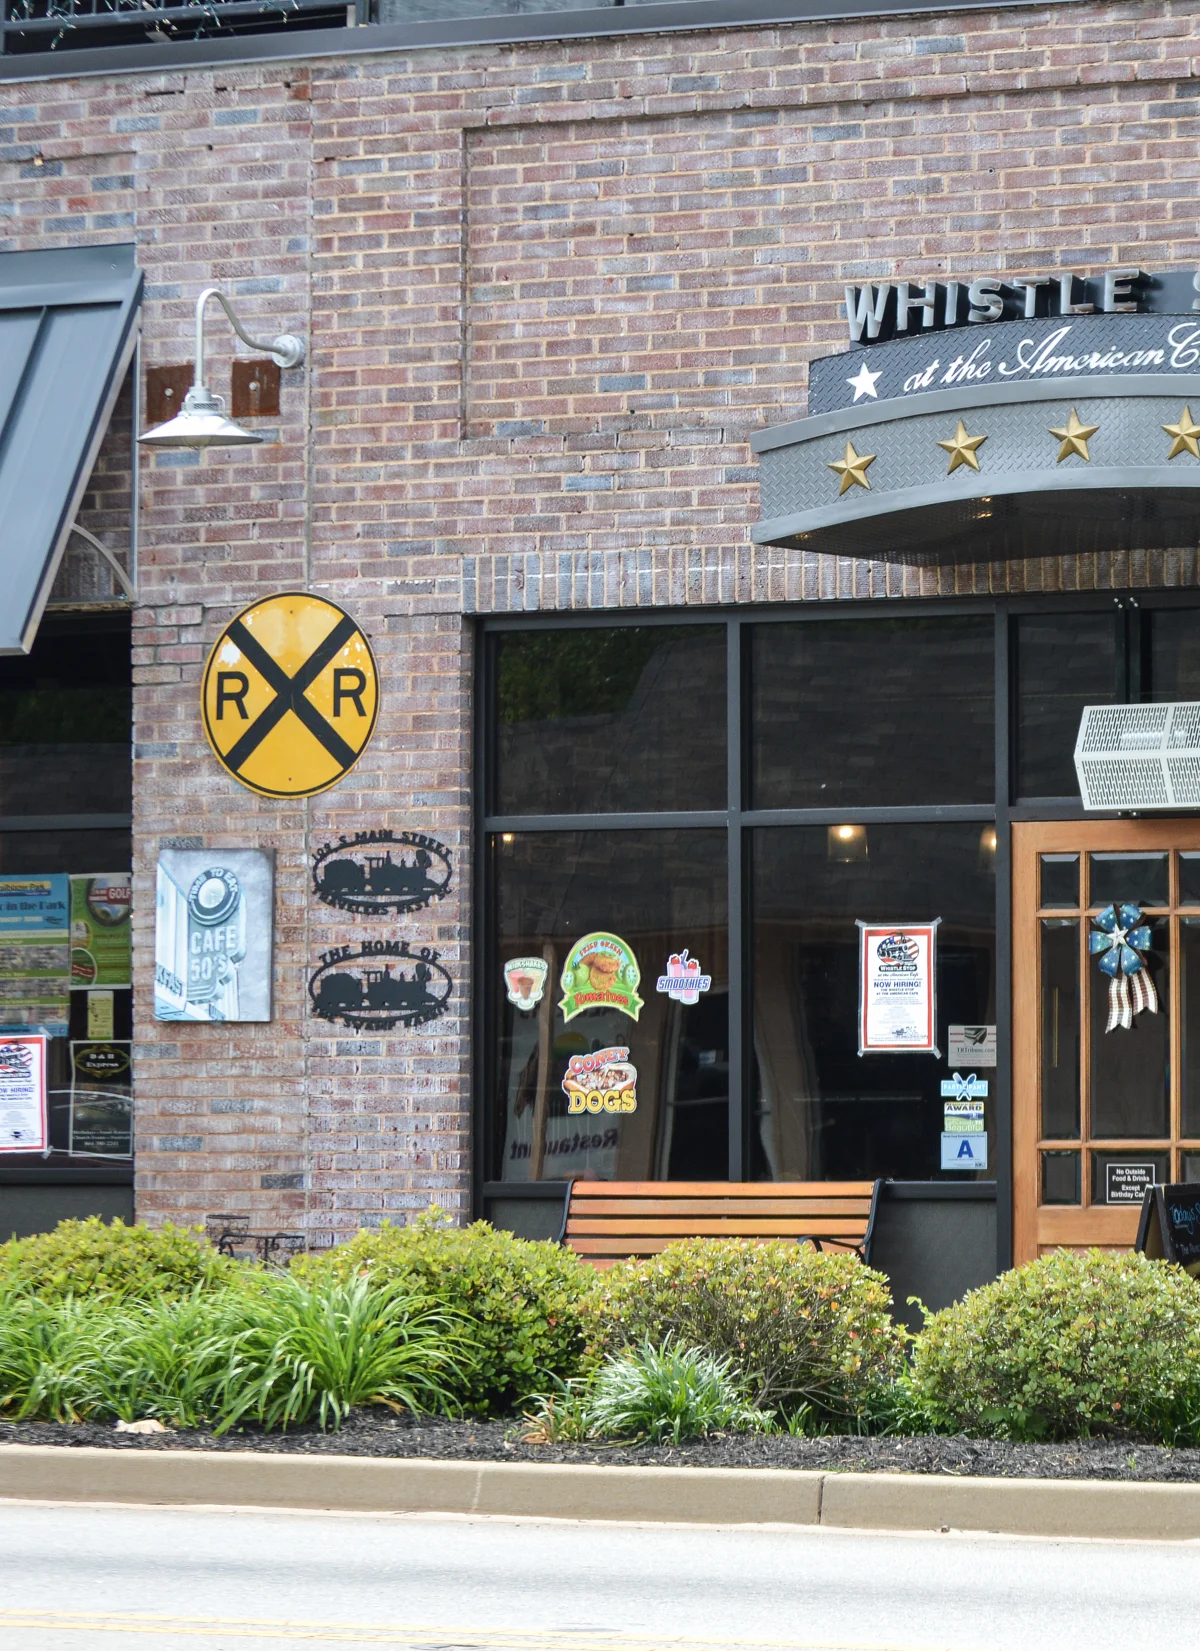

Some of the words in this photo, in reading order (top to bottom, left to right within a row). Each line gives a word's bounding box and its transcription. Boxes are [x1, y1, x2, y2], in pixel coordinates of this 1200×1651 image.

[845, 268, 1150, 342] WHISTLE
[903, 356, 940, 391] at
[940, 339, 991, 384] the
[998, 325, 1166, 376] American
[216, 670, 249, 720] R
[332, 667, 367, 718] R
[355, 829, 393, 841] MAIN
[402, 830, 453, 858] STREET
[210, 868, 224, 879] TO
[223, 872, 239, 893] EAT
[109, 888, 131, 900] GOLF
[191, 925, 237, 955] CAFE
[579, 941, 598, 956] FRIED
[600, 940, 623, 956] GREEN
[319, 945, 351, 966] THE
[361, 940, 410, 954] HOME
[420, 947, 441, 961] OF
[506, 959, 547, 972] MILKSHAKES
[191, 954, 228, 982] 50'S
[658, 976, 710, 990] SMOOTHIES
[574, 990, 629, 1007] Tomatoes
[570, 1047, 629, 1074] CONEY
[568, 1089, 636, 1113] DOGS
[957, 1140, 974, 1158] A
